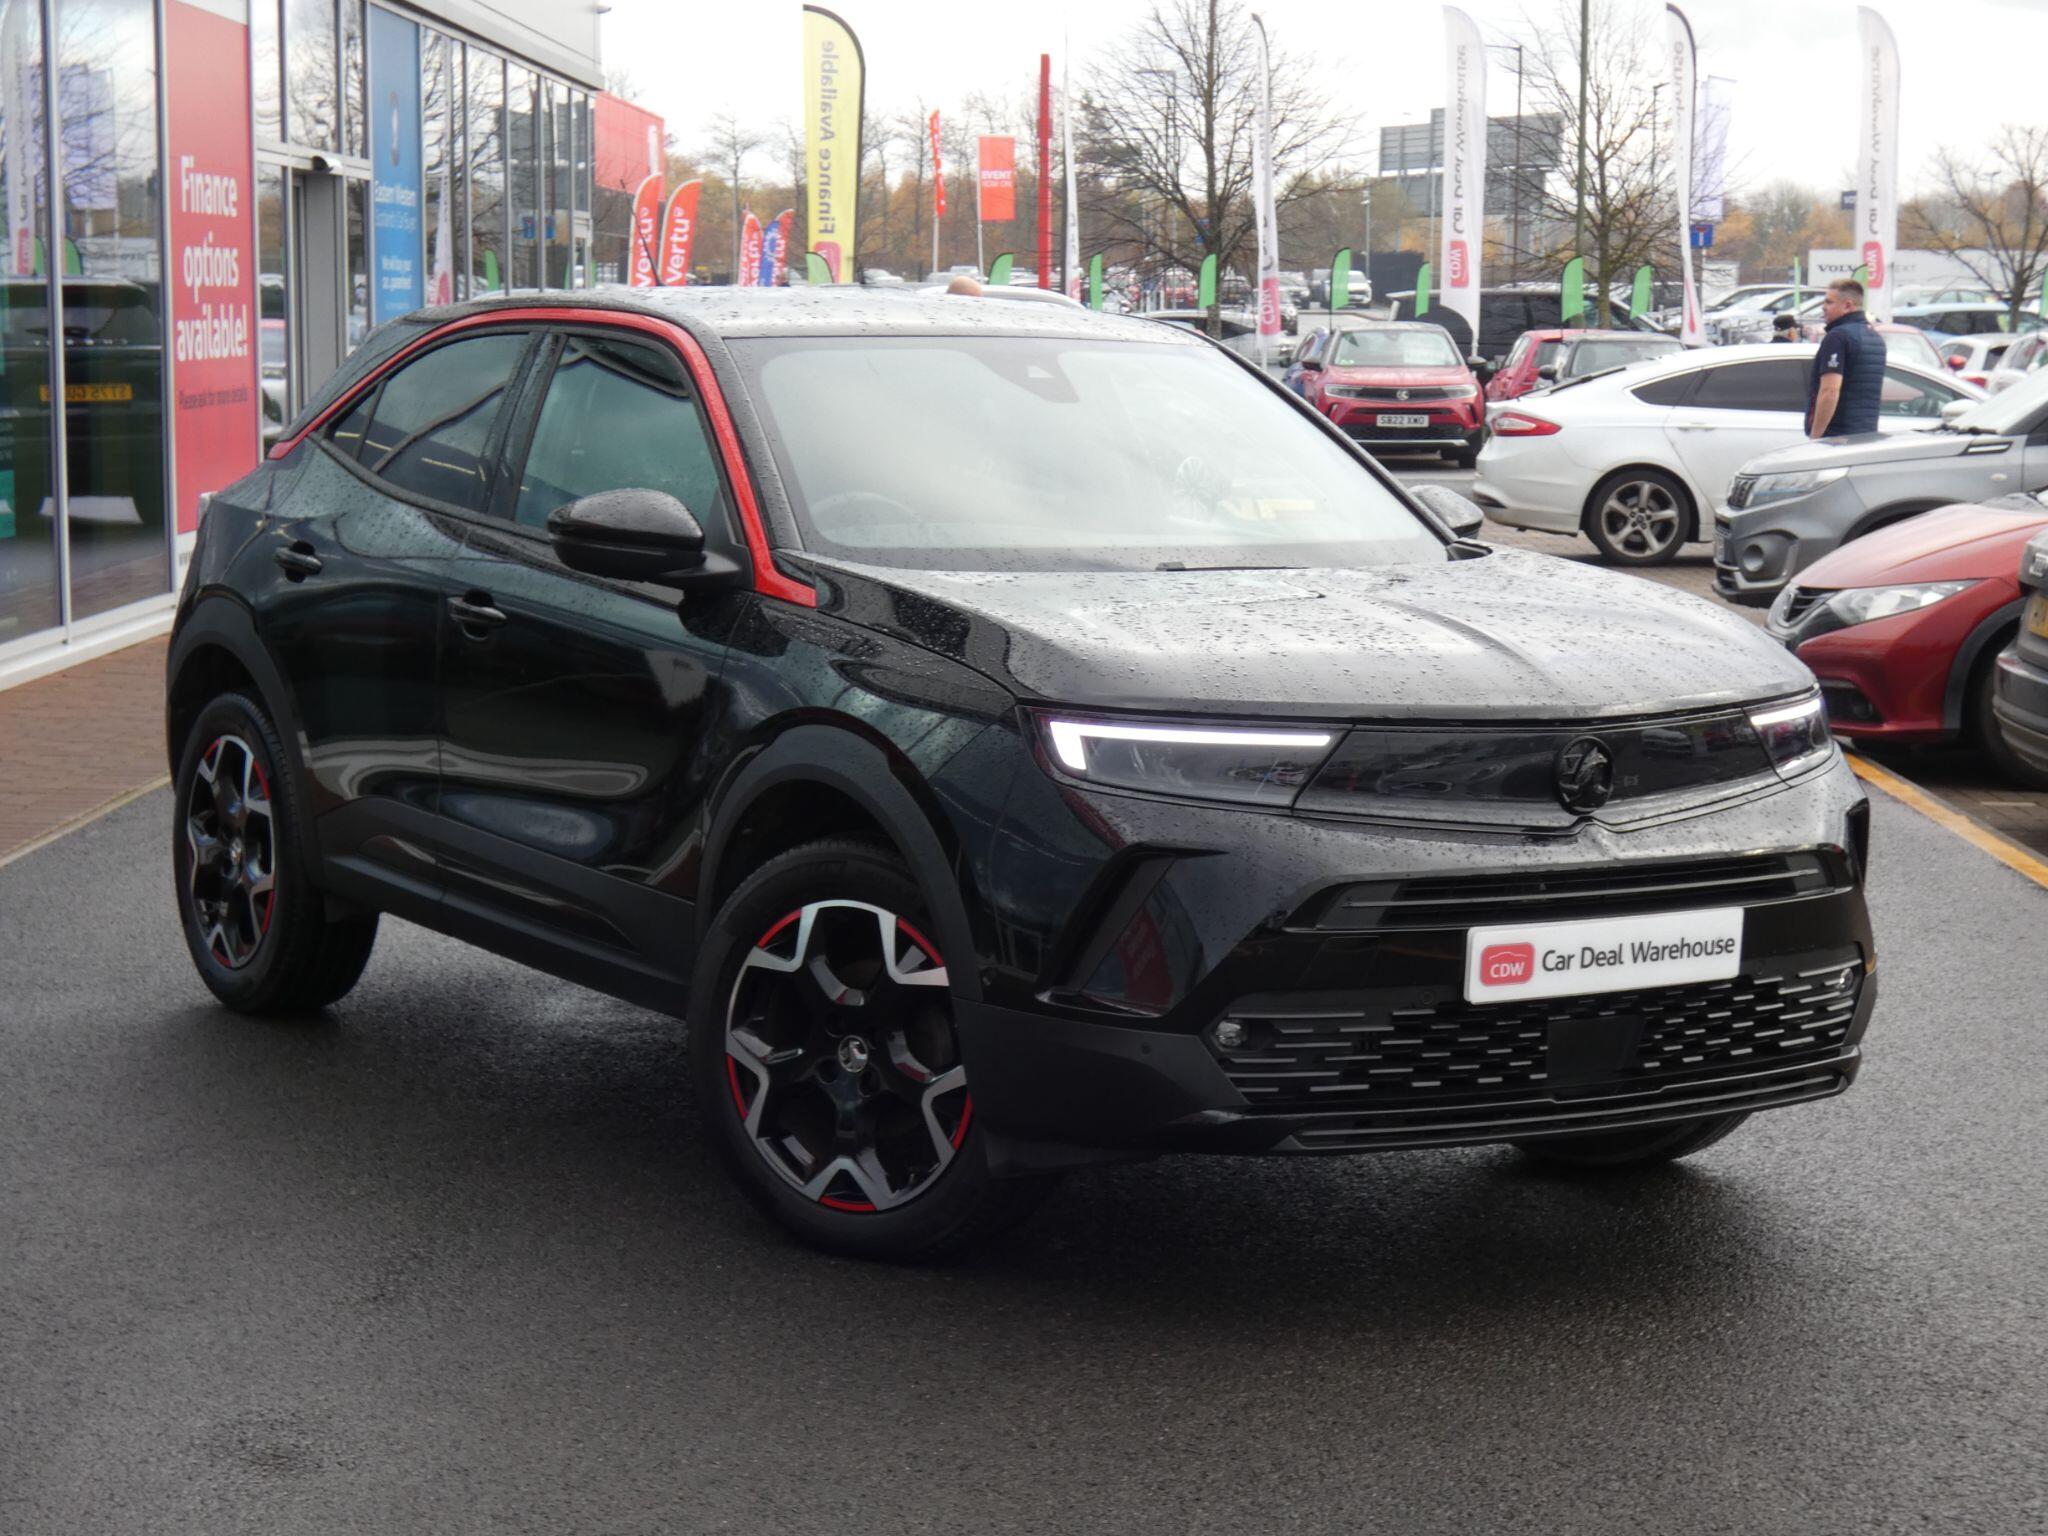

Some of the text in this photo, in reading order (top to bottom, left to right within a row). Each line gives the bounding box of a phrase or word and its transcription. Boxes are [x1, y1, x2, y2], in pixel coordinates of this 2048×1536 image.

[181, 154, 238, 218] Finance
[183, 230, 239, 304] options
[665, 218, 691, 284] Vertu
[1818, 264, 1858, 273] VOLV
[176, 303, 248, 362] available!
[1380, 415, 1405, 425] SB22
[1490, 961, 1525, 978] CDW
[1542, 937, 1736, 972] Car Deal Warehouse
